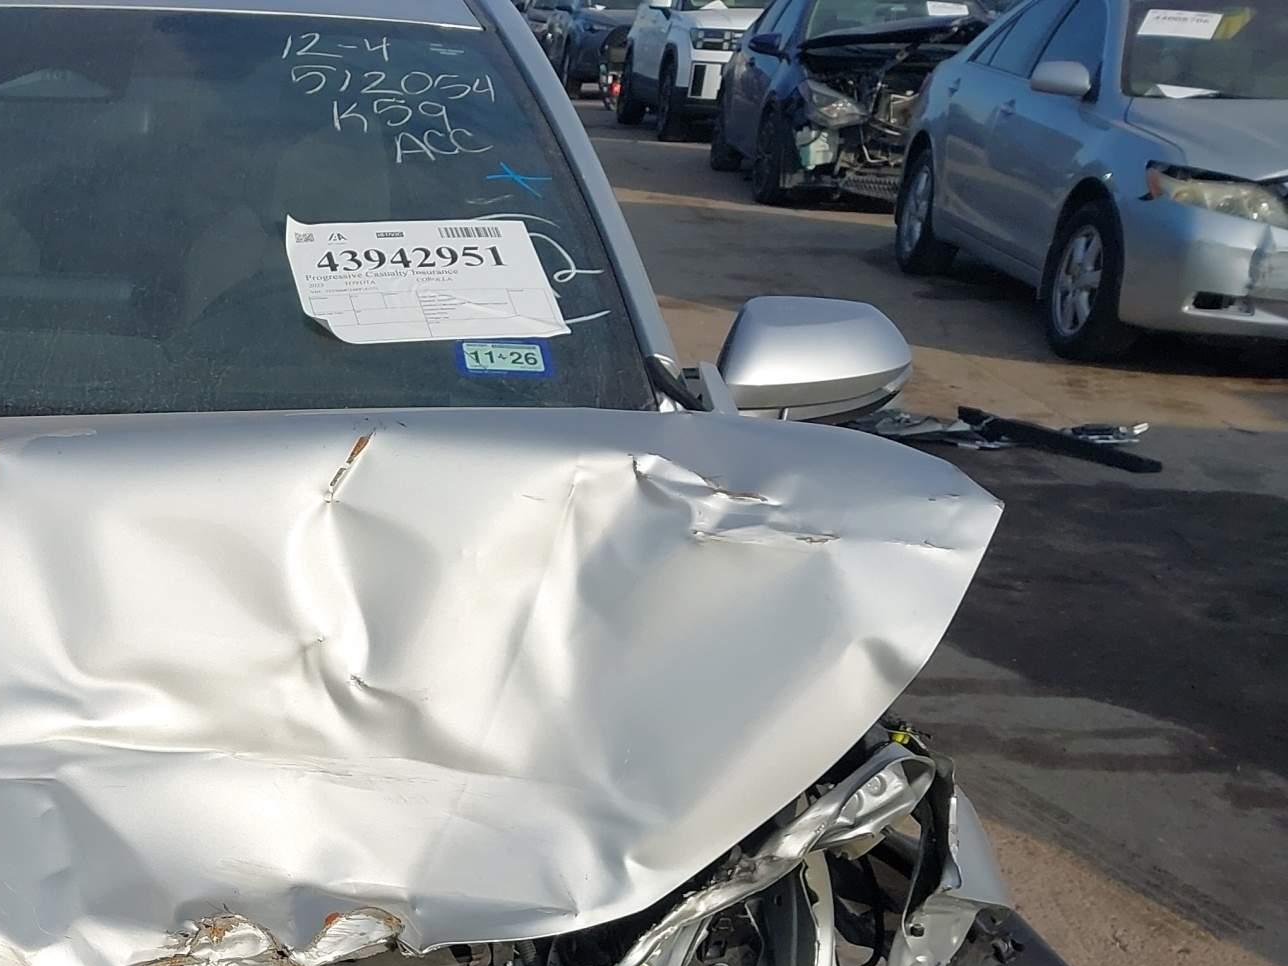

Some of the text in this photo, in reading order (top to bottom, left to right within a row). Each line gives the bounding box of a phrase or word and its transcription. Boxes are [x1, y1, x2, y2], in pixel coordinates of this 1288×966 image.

[282, 32, 391, 62] 12-4
[291, 65, 495, 102] 512054
[332, 98, 451, 133] K59
[394, 129, 494, 163] ACC
[316, 245, 507, 272] 43942951
[305, 273, 363, 281] Progressive
[365, 269, 408, 278] Casualty
[509, 351, 539, 366] 26
